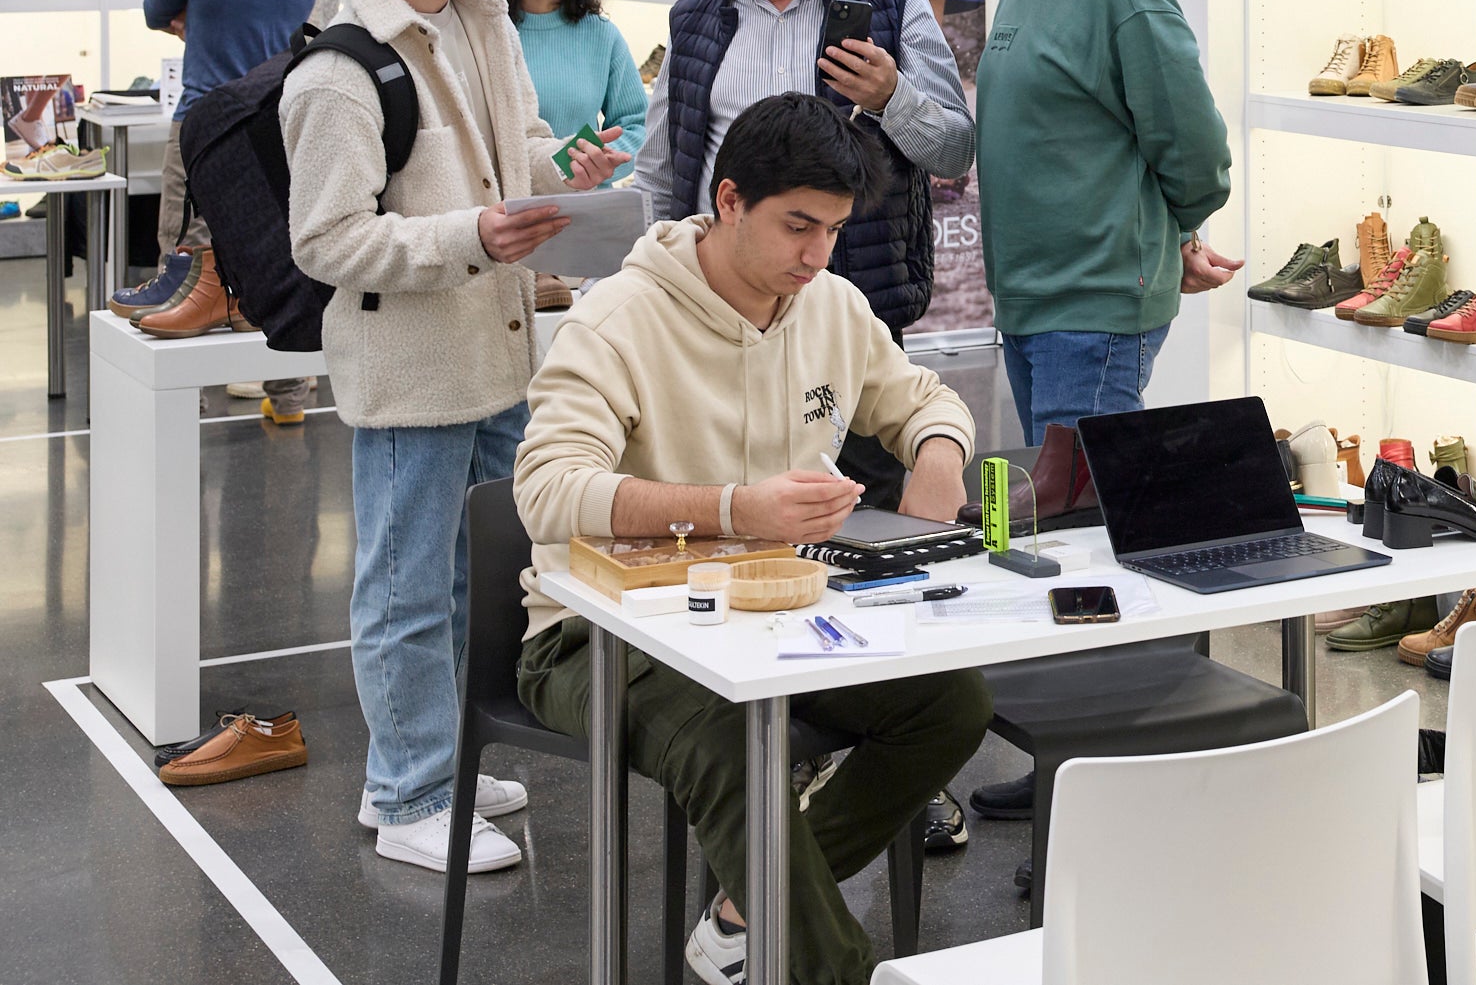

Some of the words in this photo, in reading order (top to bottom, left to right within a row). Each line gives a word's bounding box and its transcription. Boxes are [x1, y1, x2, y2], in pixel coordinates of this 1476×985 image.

[13, 83, 59, 93] NATURAL
[804, 383, 833, 403] ROCK
[818, 394, 836, 408] IN
